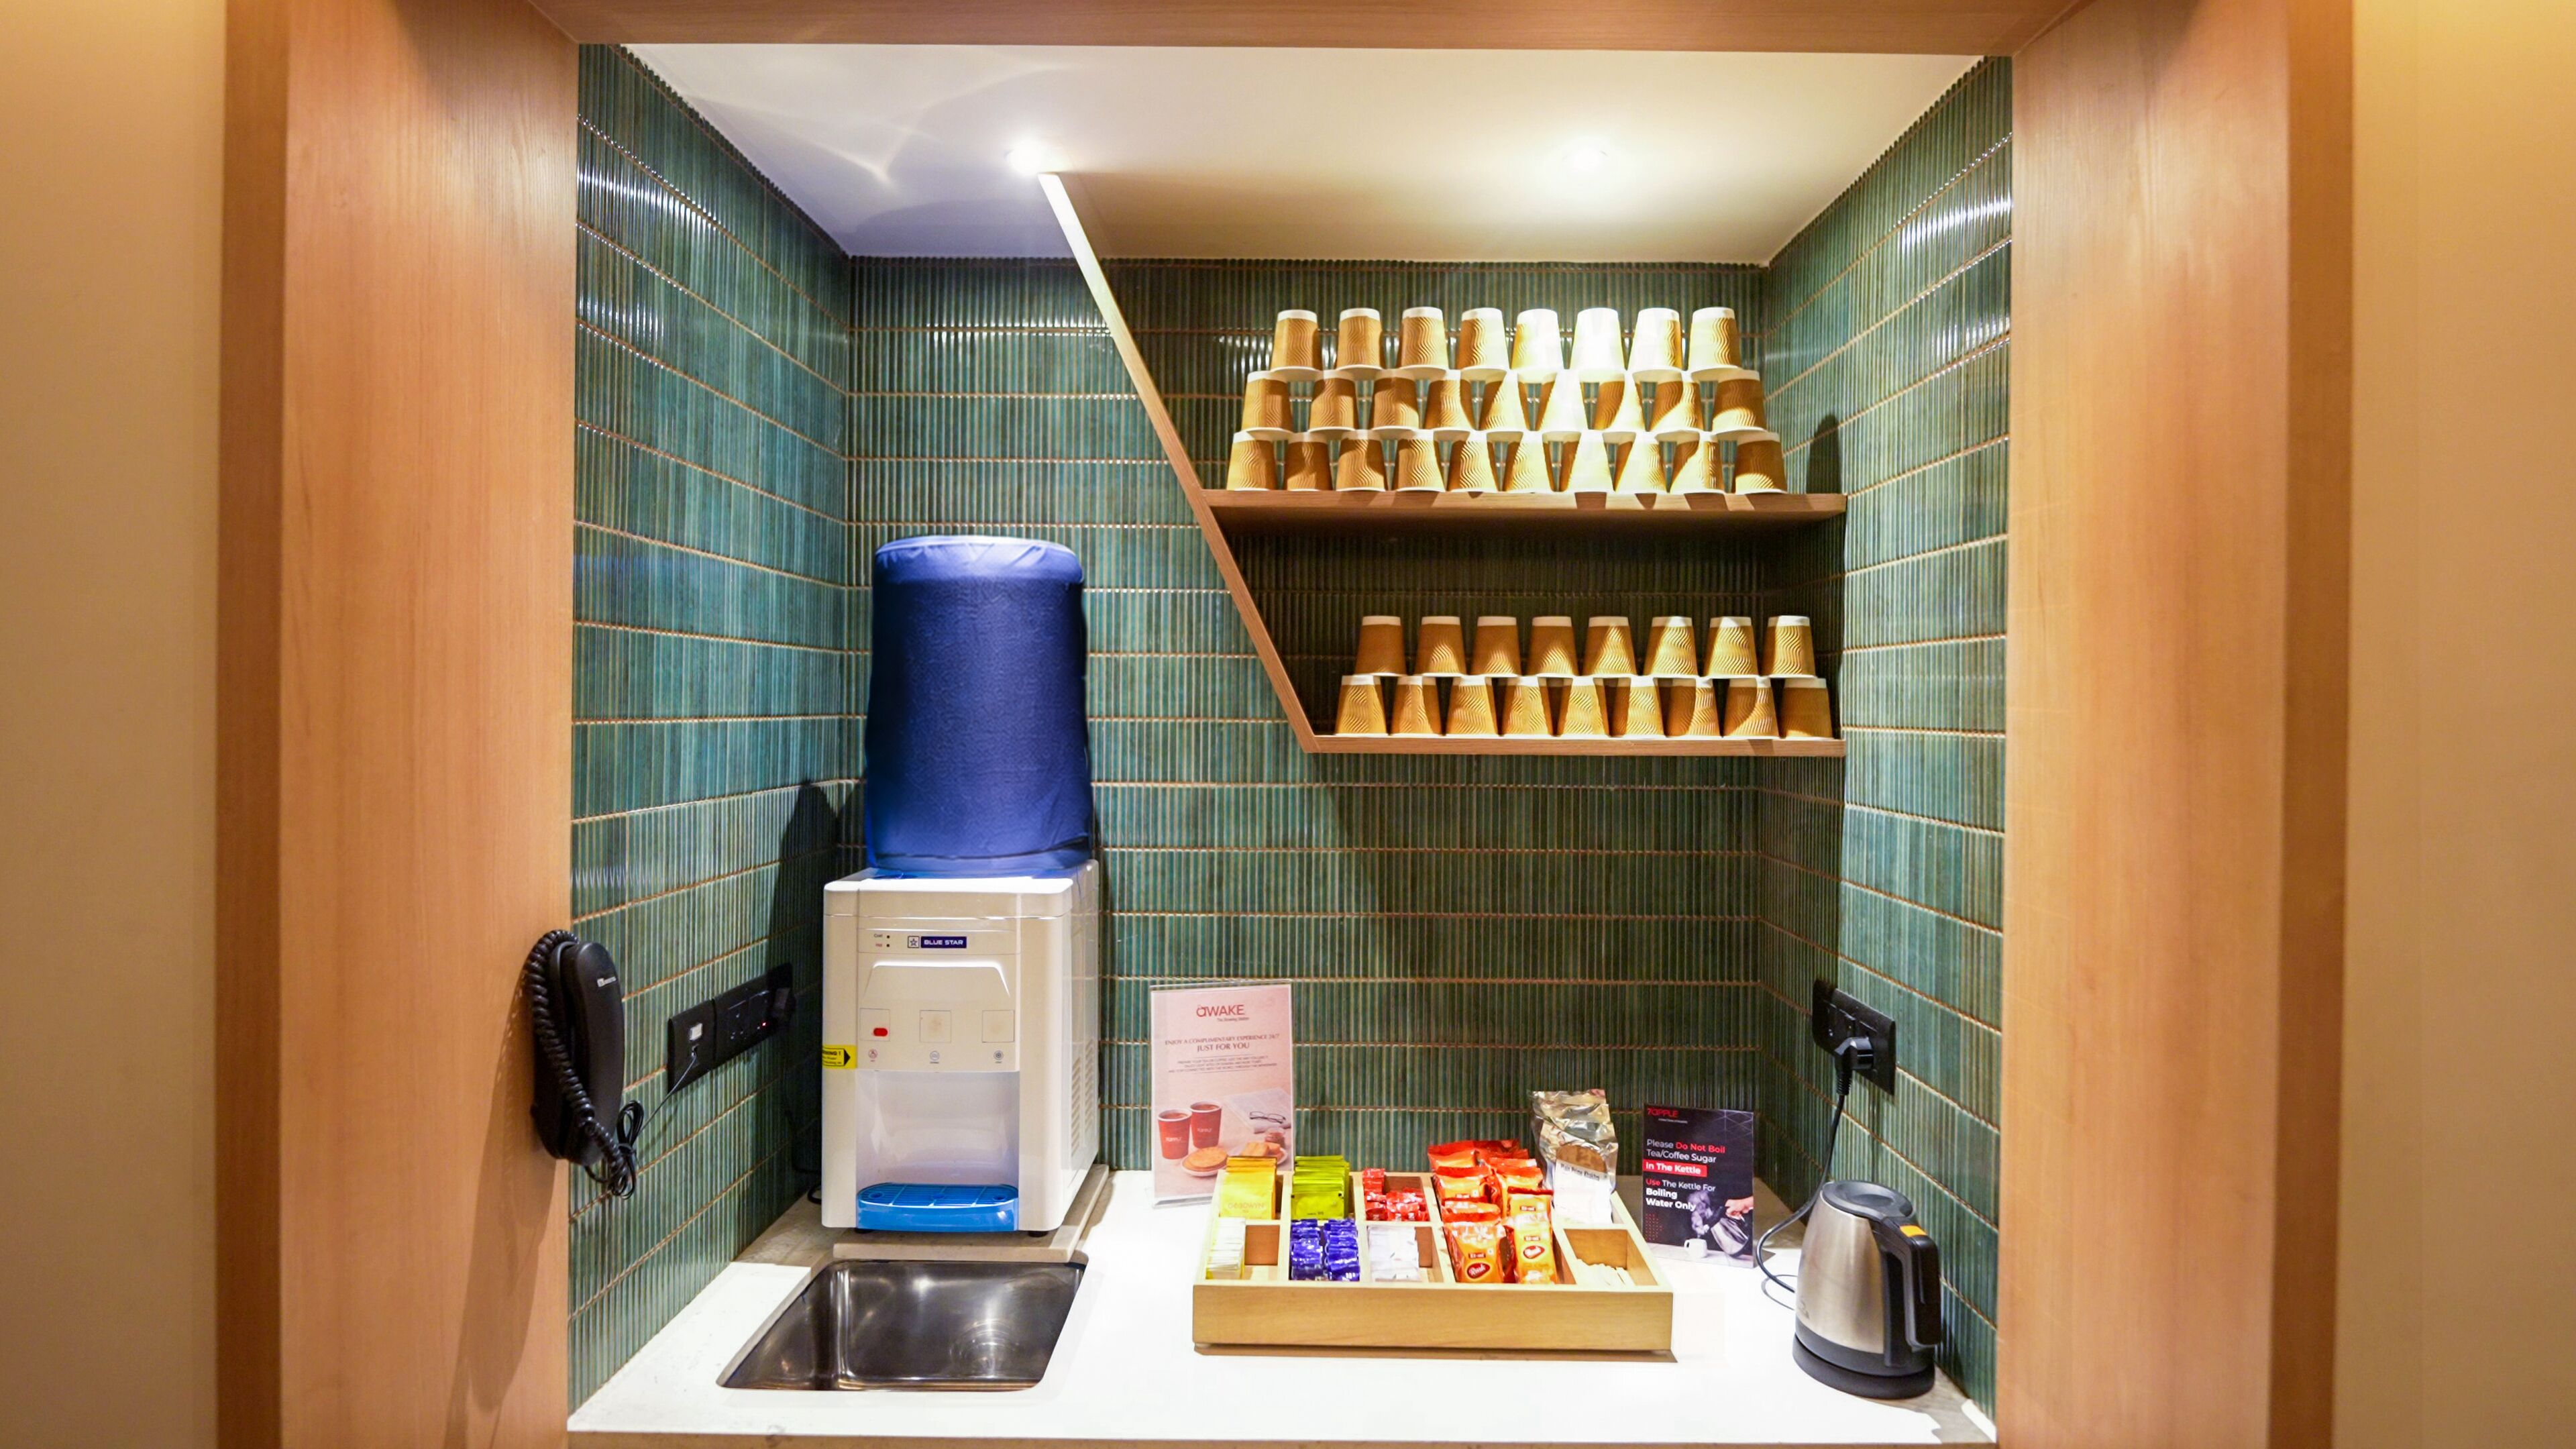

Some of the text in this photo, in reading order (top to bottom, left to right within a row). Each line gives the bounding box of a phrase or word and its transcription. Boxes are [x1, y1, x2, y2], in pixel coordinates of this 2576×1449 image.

[1647, 1139, 1725, 1153] Please Do Not Boil
[1646, 1148, 1717, 1164] Tea/Coffee Sugar
[1656, 1163, 1672, 1171] The
[1674, 1165, 1701, 1175] Kettle
[1662, 1179, 1676, 1188] The
[1678, 1181, 1701, 1191] Kettle
[1703, 1184, 1716, 1192] For
[1646, 1187, 1678, 1199] Boiling
[1646, 1197, 1696, 1212] Water Only
